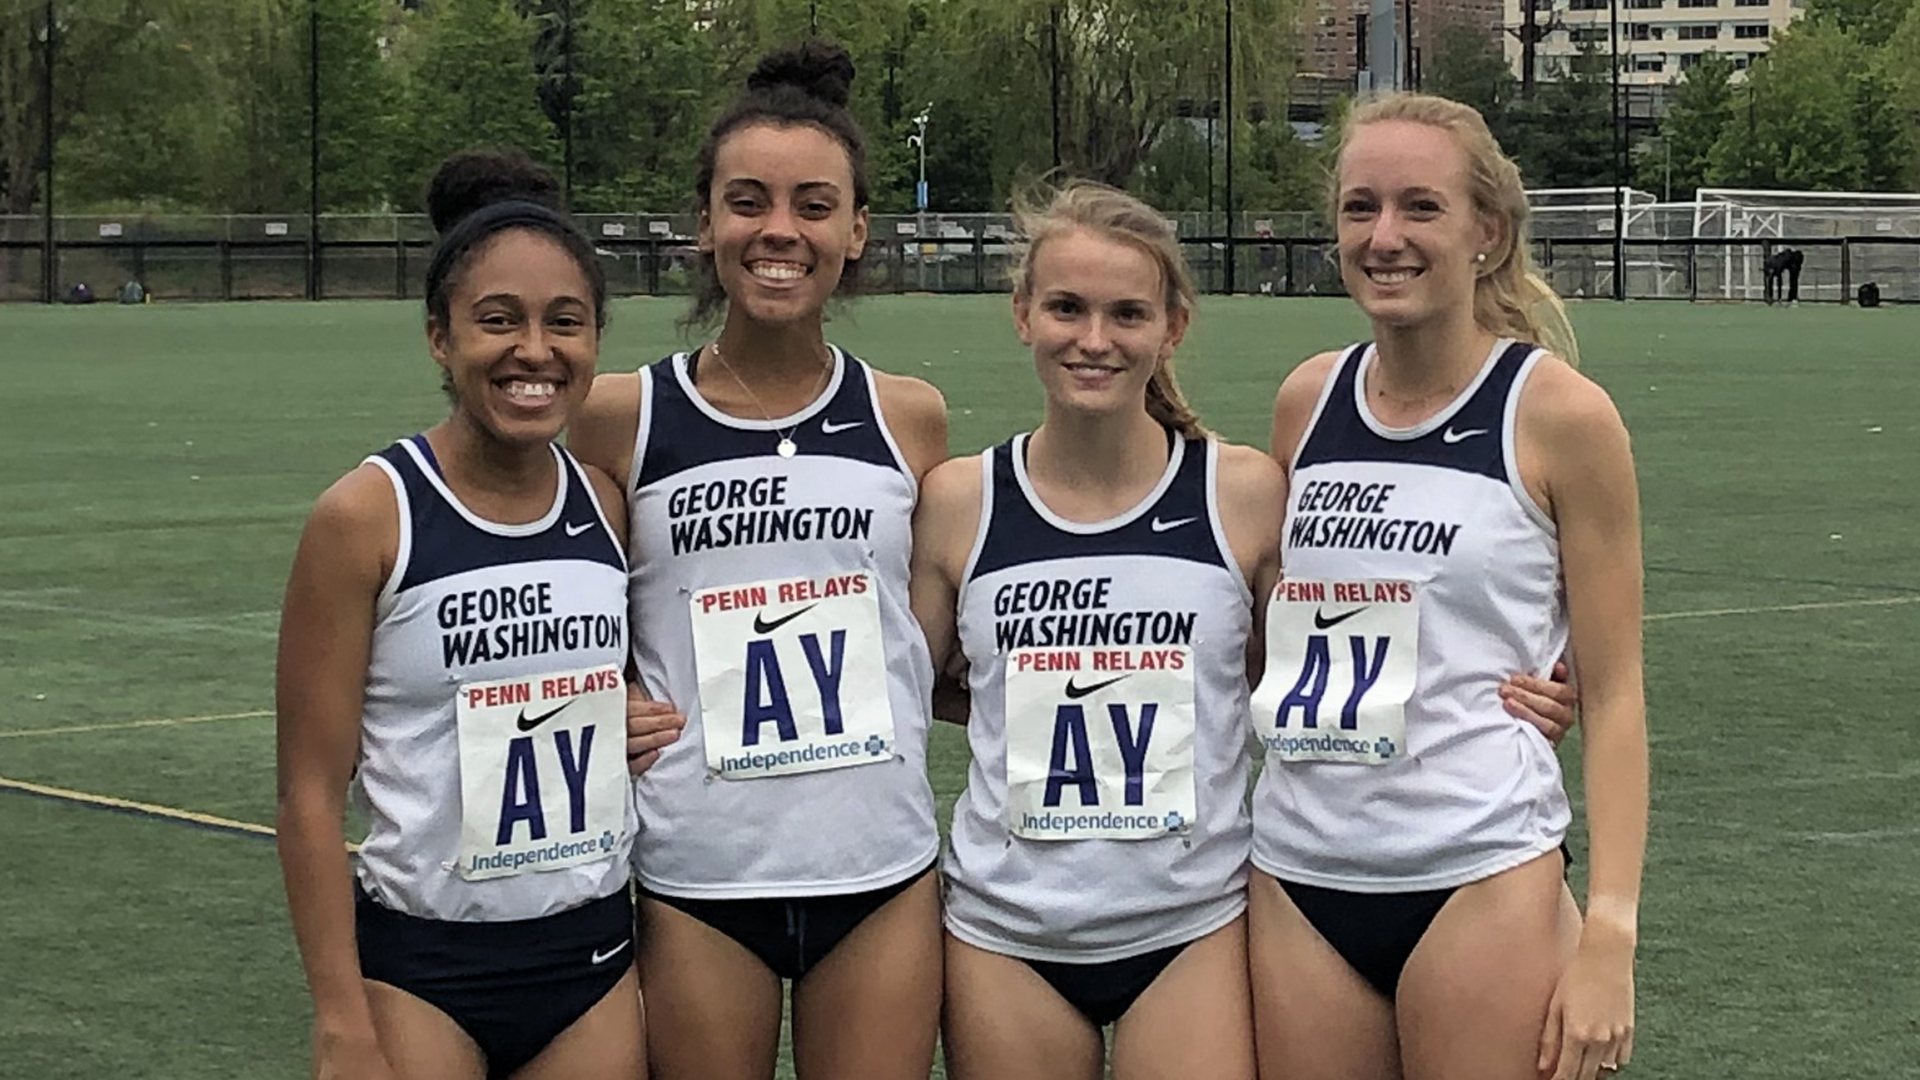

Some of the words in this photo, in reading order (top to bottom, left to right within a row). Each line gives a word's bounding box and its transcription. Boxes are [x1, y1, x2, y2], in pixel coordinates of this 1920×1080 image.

[668, 476, 788, 519] GEORGE
[1297, 480, 1395, 514] GEORGE
[671, 507, 874, 556] WASHINGTON
[1288, 515, 1463, 556] WASHINGTON
[437, 582, 553, 629] GEORGE
[702, 587, 767, 613] PENN
[779, 574, 868, 603] RELAYS
[994, 577, 1112, 617] GEORGE
[1276, 582, 1325, 602] PENN
[1334, 582, 1413, 603] RELAYS
[442, 614, 622, 668] WASHINGTON
[996, 611, 1198, 653] WASHINGTON
[1018, 652, 1080, 672] PENN
[1093, 650, 1185, 671] RELAYS
[469, 682, 530, 709] PENN
[542, 670, 619, 700] RELAYS
[741, 629, 847, 747] AY
[1275, 634, 1391, 731] AY
[720, 741, 861, 772] Independence
[1043, 703, 1159, 807] AY
[496, 724, 596, 847] AY
[1022, 812, 1159, 833] Independence
[472, 838, 597, 871] Independence
